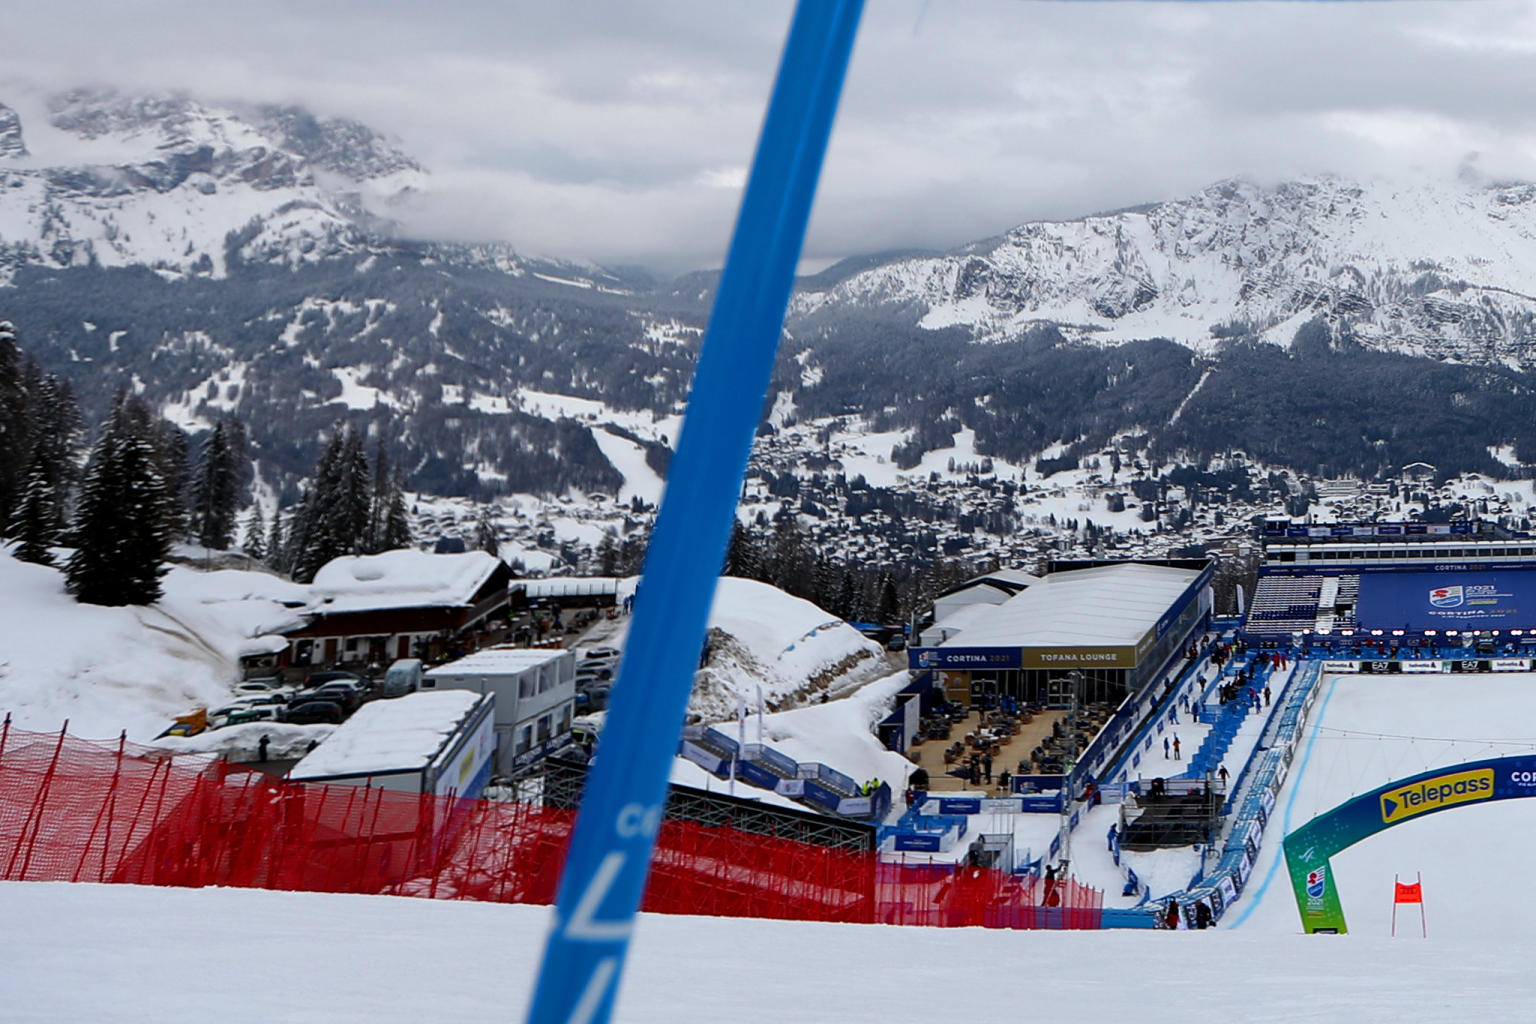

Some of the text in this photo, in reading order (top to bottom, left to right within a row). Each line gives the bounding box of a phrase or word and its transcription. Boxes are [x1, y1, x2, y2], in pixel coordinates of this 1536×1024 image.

[946, 654, 987, 662] CORTINA
[1040, 652, 1118, 662] TOFANA LOUNGE
[1371, 661, 1389, 670] EA7
[1461, 660, 1478, 669] EA7
[1398, 777, 1490, 809] Telepass
